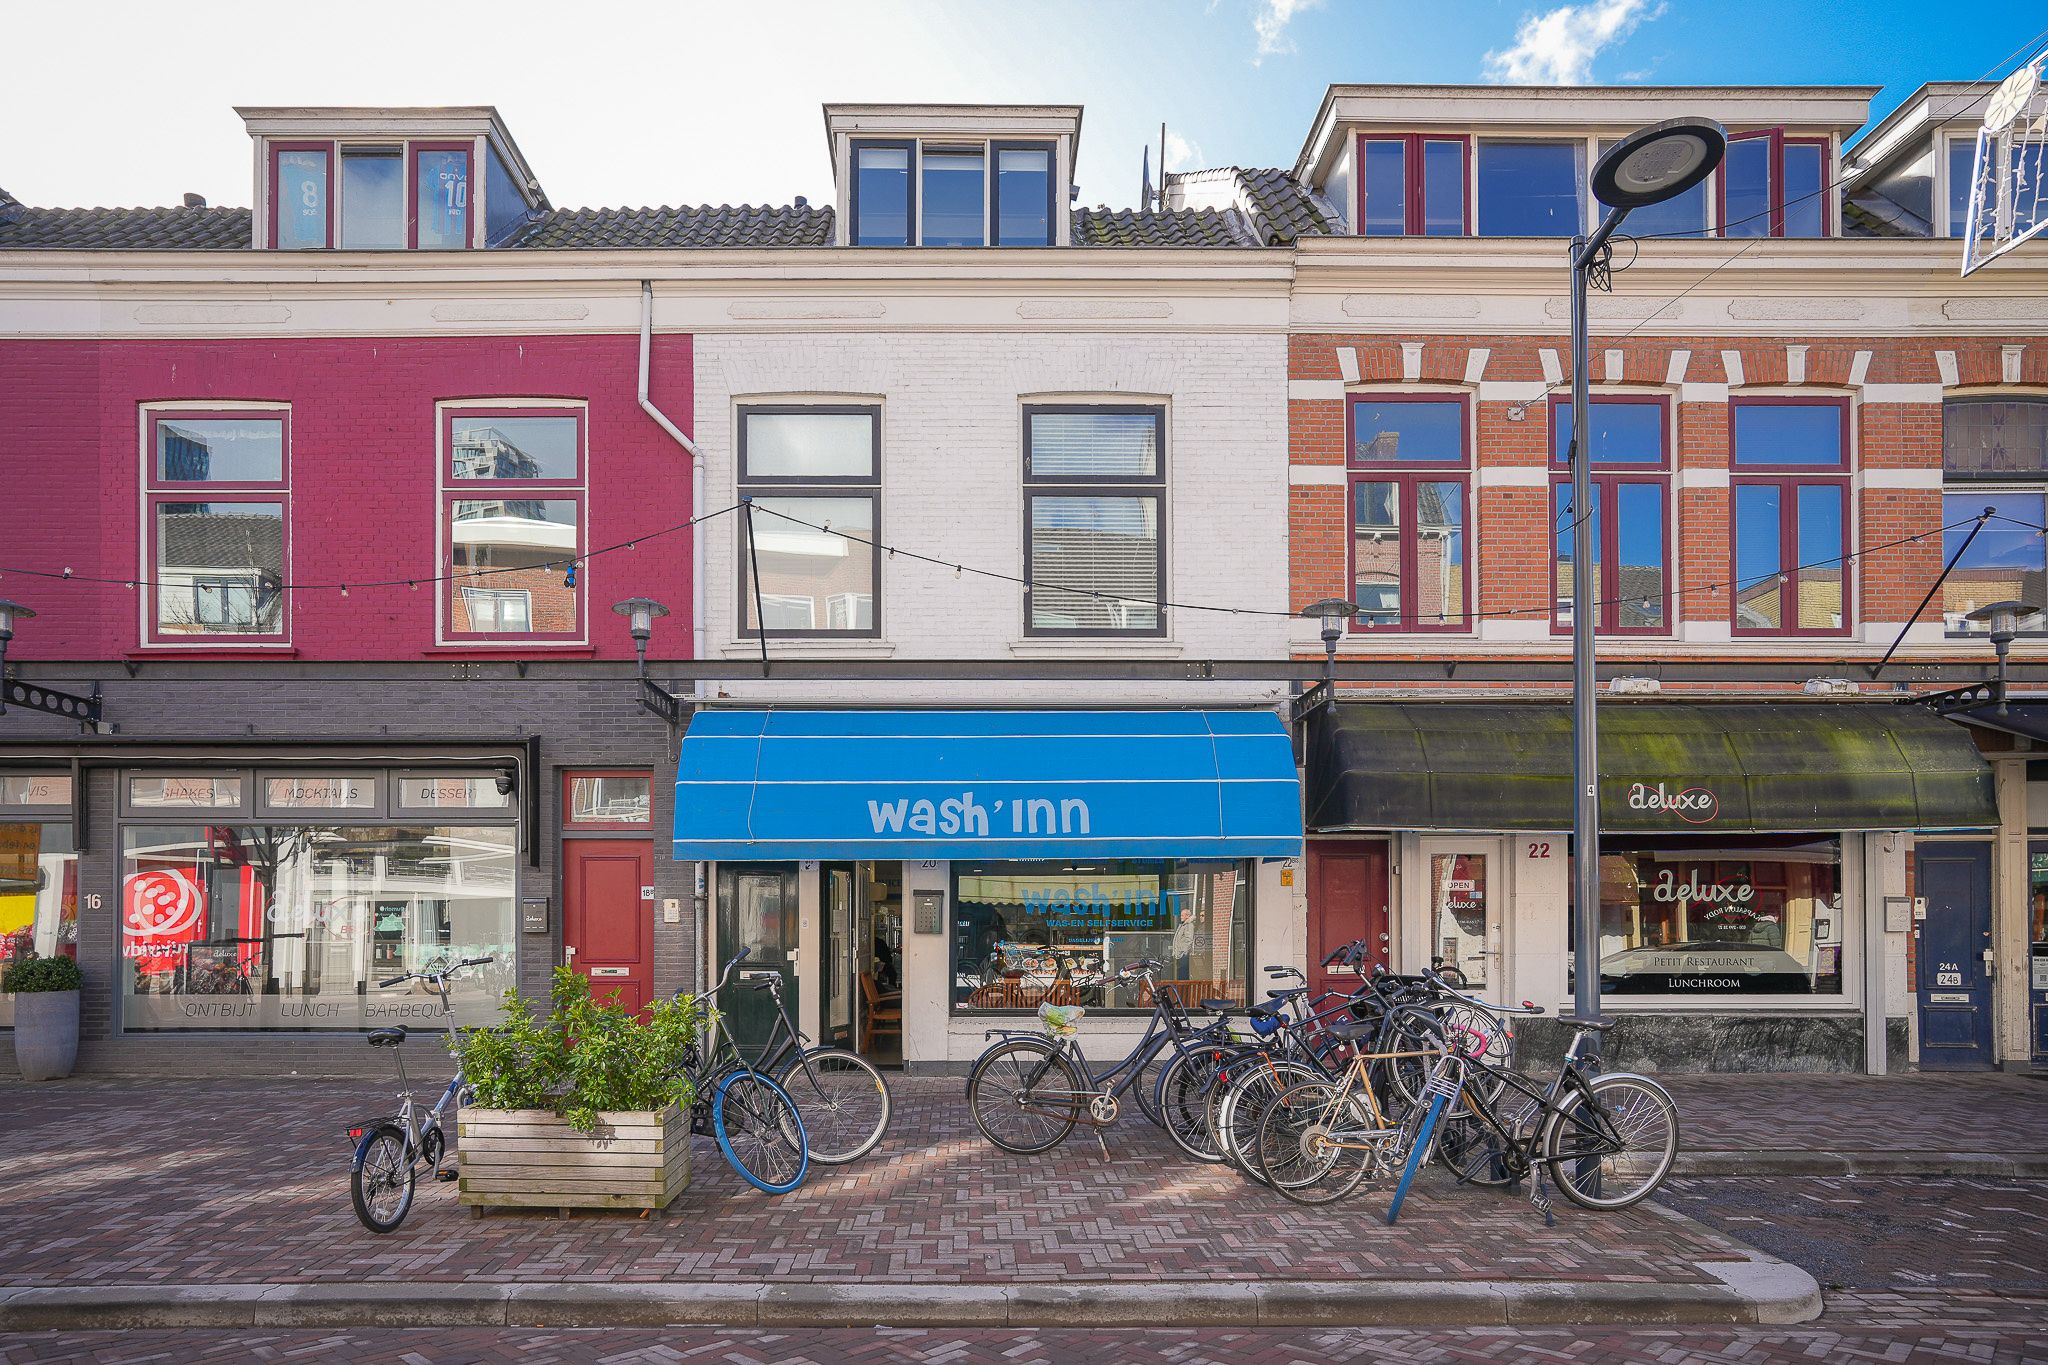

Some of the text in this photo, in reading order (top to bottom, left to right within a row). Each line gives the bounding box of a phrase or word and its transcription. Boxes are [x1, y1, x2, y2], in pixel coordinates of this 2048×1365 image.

[301, 181, 318, 207] 8
[445, 181, 466, 207] 10
[162, 788, 214, 798] SHAKES
[284, 788, 358, 799] MOCKTAIS
[1588, 786, 1593, 794] 4
[1629, 783, 1712, 809] deluxe
[1528, 843, 1550, 858] 22
[1654, 869, 1755, 902] deluxe
[84, 894, 101, 909] 16
[1447, 897, 1477, 908] eluxe
[1087, 919, 1153, 927] SELFSERVICE
[1654, 957, 1754, 966] PETIT RESTAURANT
[1668, 978, 1740, 988] LUNCHROOM
[185, 1003, 257, 1017] ONTBIJT
[281, 1003, 340, 1017] LUNCH
